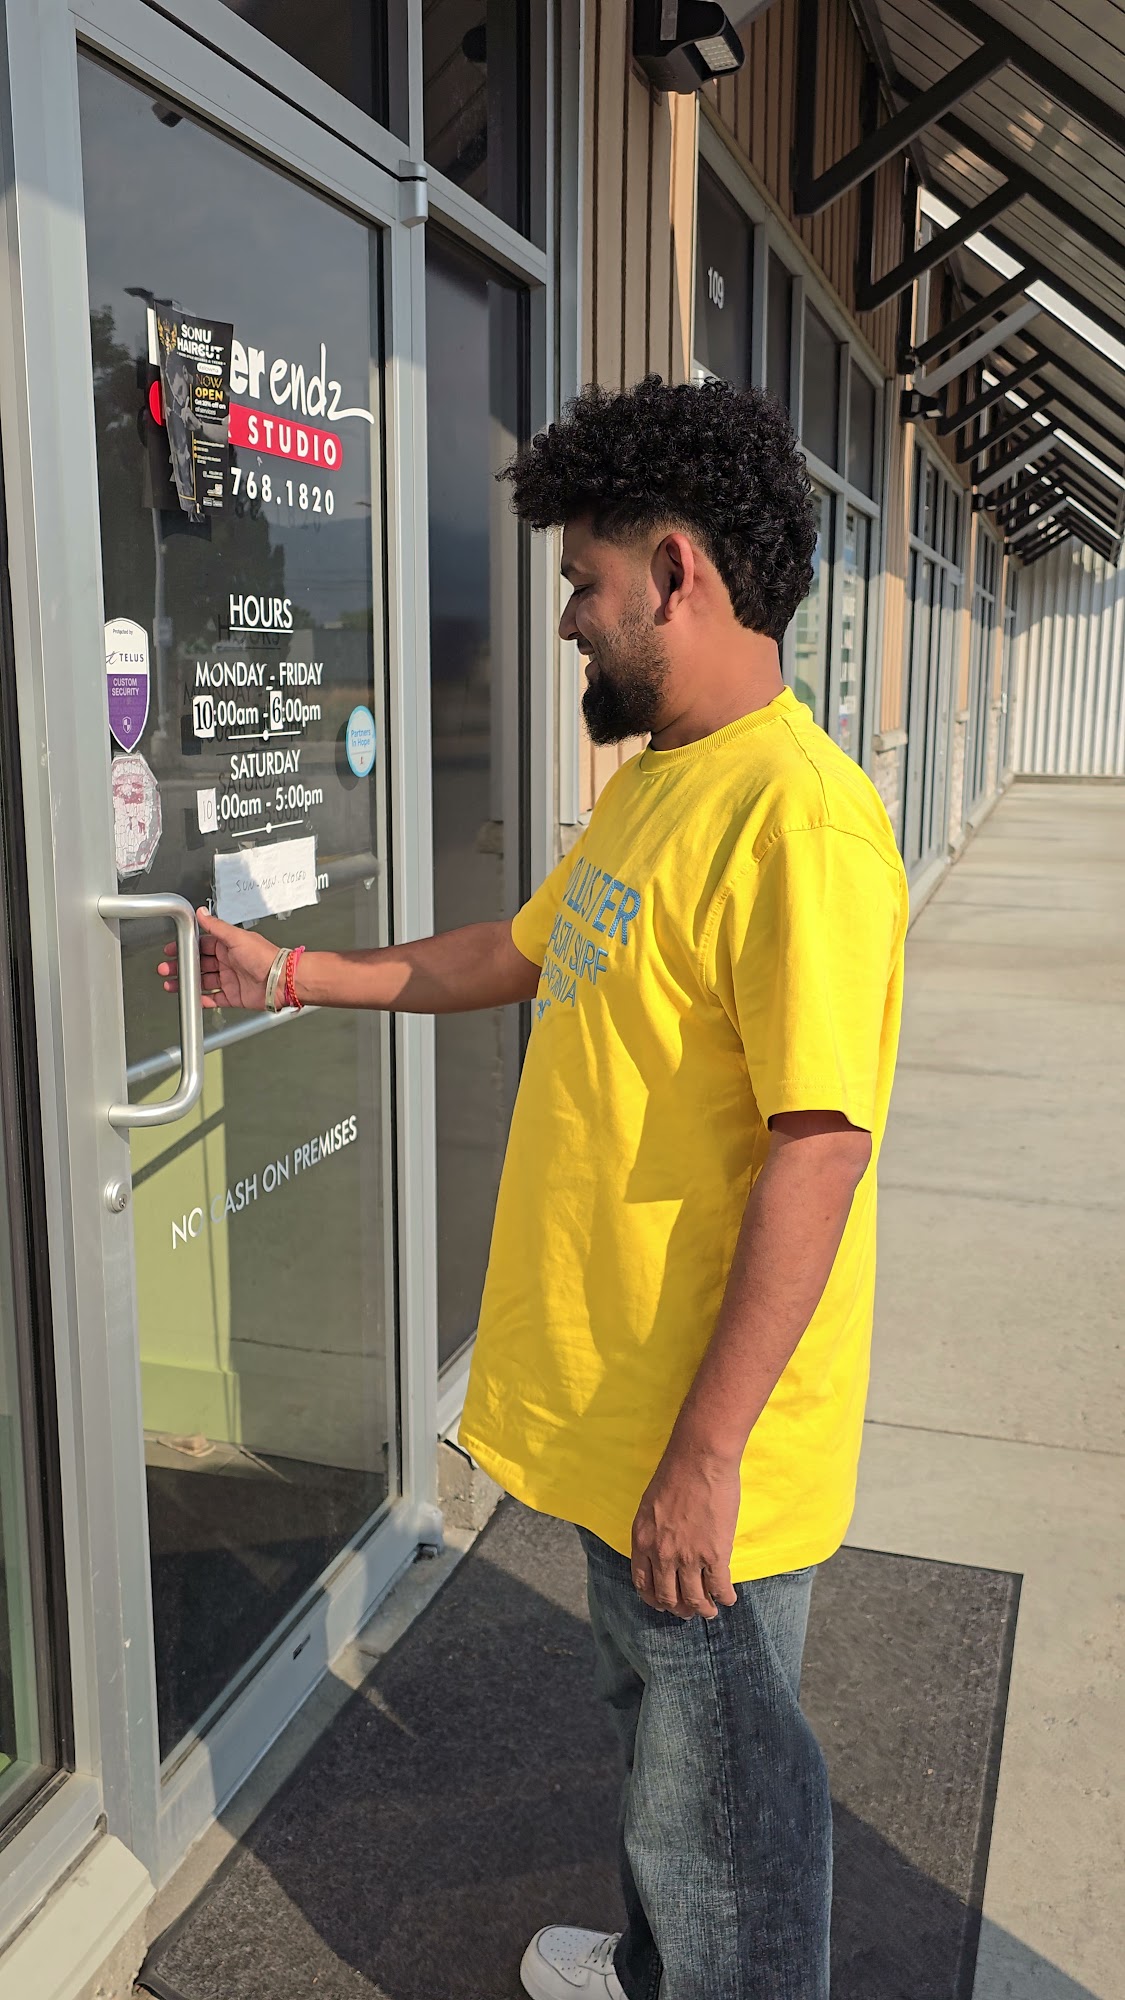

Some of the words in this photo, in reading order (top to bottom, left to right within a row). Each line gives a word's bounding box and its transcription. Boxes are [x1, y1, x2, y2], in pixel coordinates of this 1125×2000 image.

[708, 266, 724, 310] 109
[181, 323, 212, 344] SONU
[177, 337, 224, 360] HAIRCUT
[195, 374, 223, 389] NOW
[195, 387, 223, 402] OPEN
[248, 415, 337, 466] STUDIO
[230, 466, 334, 516] 768.1820
[229, 594, 293, 629] HOURS
[119, 653, 144, 663] TELUS
[113, 677, 138, 687] CUSTOM
[195, 661, 267, 688] MONDAY
[279, 662, 324, 686] FRIDAY
[111, 687, 139, 697] SECURITY
[194, 699, 259, 731] 10:00am
[272, 696, 321, 728] 6:00pm
[350, 729, 371, 739] Partners
[358, 738, 370, 748] Hope
[230, 749, 301, 780] SATURDAY
[275, 784, 323, 813] 5:00pm
[171, 1207, 204, 1250] NO
[210, 1174, 257, 1224] CASH
[262, 1155, 289, 1193] ON
[294, 1115, 358, 1175] PREMISES
